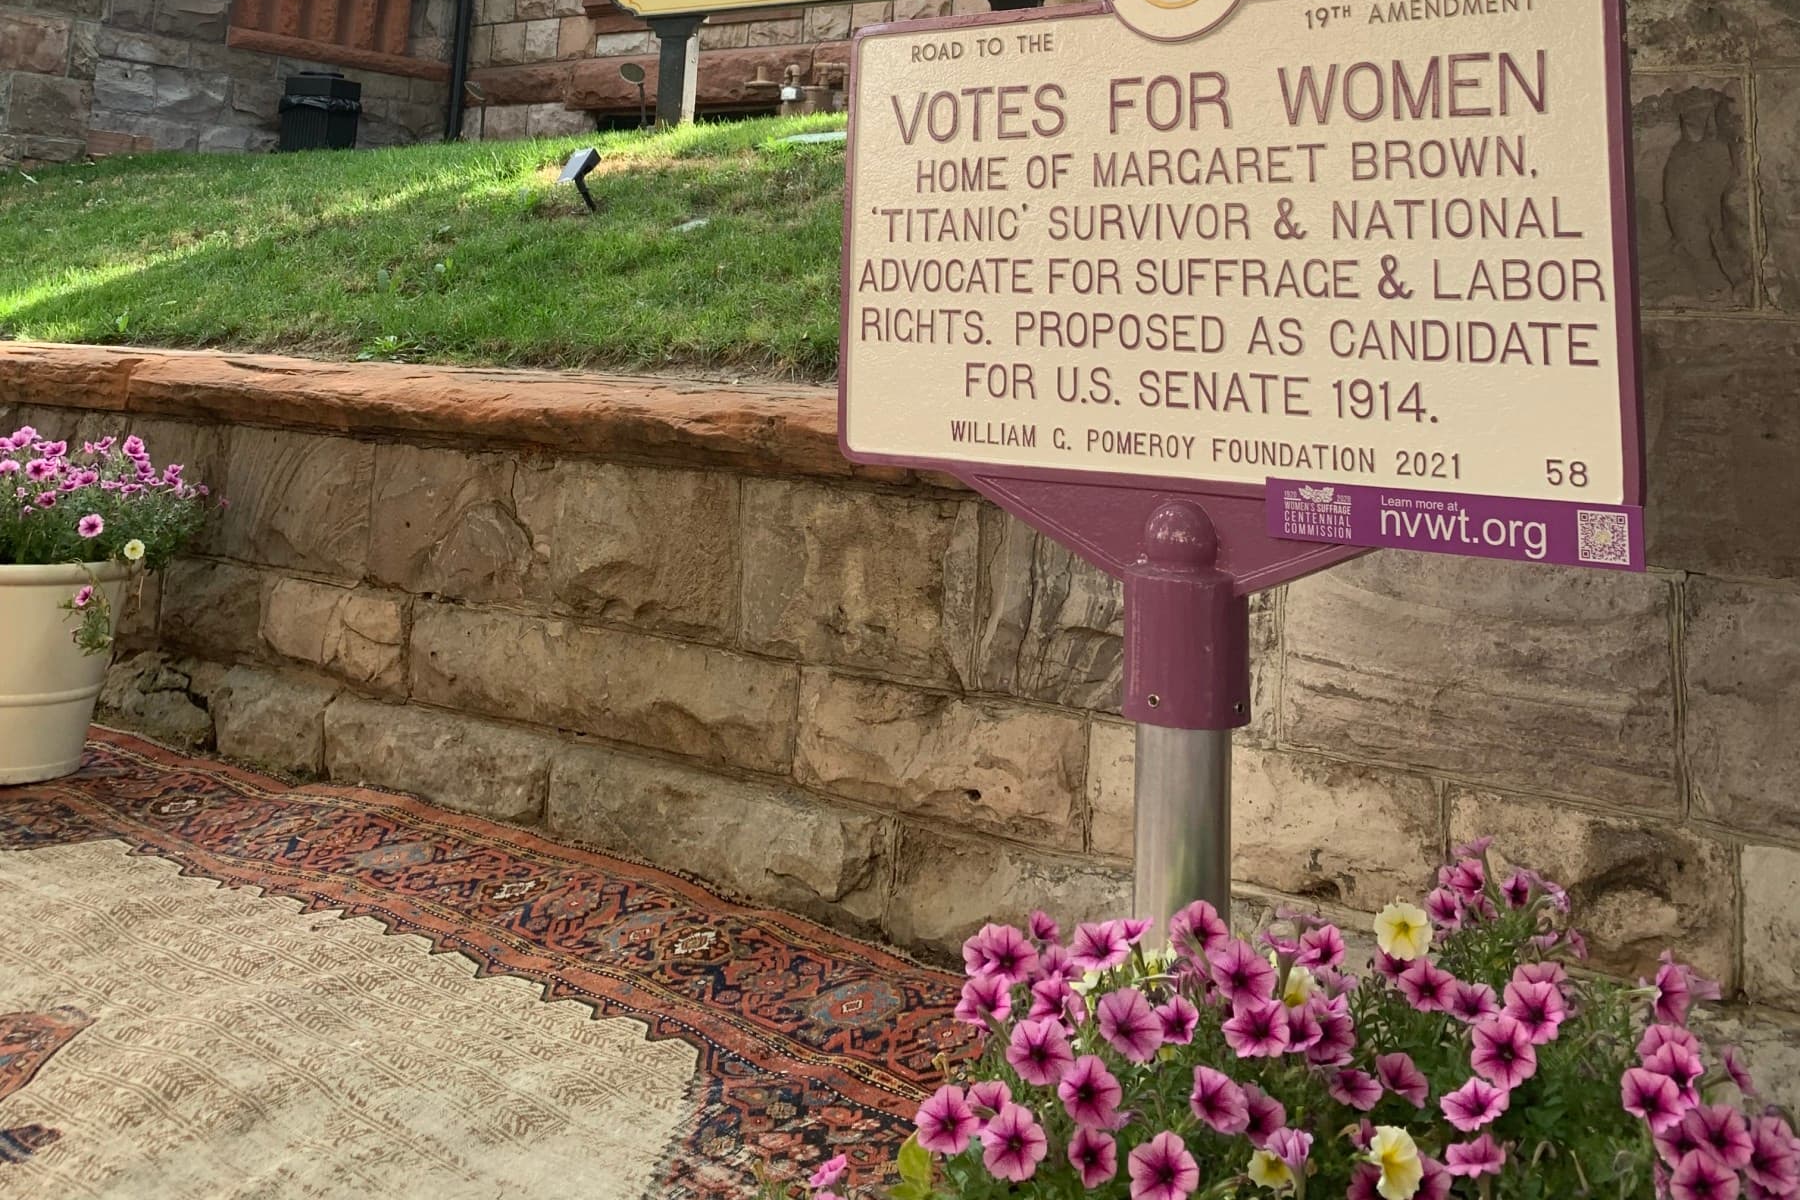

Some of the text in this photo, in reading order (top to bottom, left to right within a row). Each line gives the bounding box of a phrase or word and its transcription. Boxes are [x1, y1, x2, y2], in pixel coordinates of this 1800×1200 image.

[1304, 4, 1352, 29] 19TH
[911, 33, 1055, 62] ROAD TO THE
[890, 49, 1547, 145] VOTES FOR WOMEN
[916, 156, 1009, 194] HOME
[1025, 153, 1074, 190] OF
[1092, 143, 1327, 189] MARGARET
[1048, 202, 1252, 241] SURVIVOR
[1273, 197, 1308, 242] &
[1332, 196, 1584, 241] NATIONAL
[858, 254, 1606, 302] ADVOCATE FOR SUFFRAGE & LABOR
[860, 307, 1601, 367] RIGHTS. PROPOSED AS CANDIDATE
[964, 362, 1440, 424] FOR U.S. SENATE 1914.
[950, 420, 1462, 480] WILLIAM G. POMEROY FOUNDATION 2021
[1545, 457, 1589, 489] 58
[1284, 501, 1352, 516] WOMEN'S SUFFRAGE
[1284, 510, 1352, 528] CENTENNIAL
[1380, 494, 1459, 512] Learn more at
[1284, 521, 1352, 540] COMMISSION
[1380, 508, 1547, 560] nvwt.org
